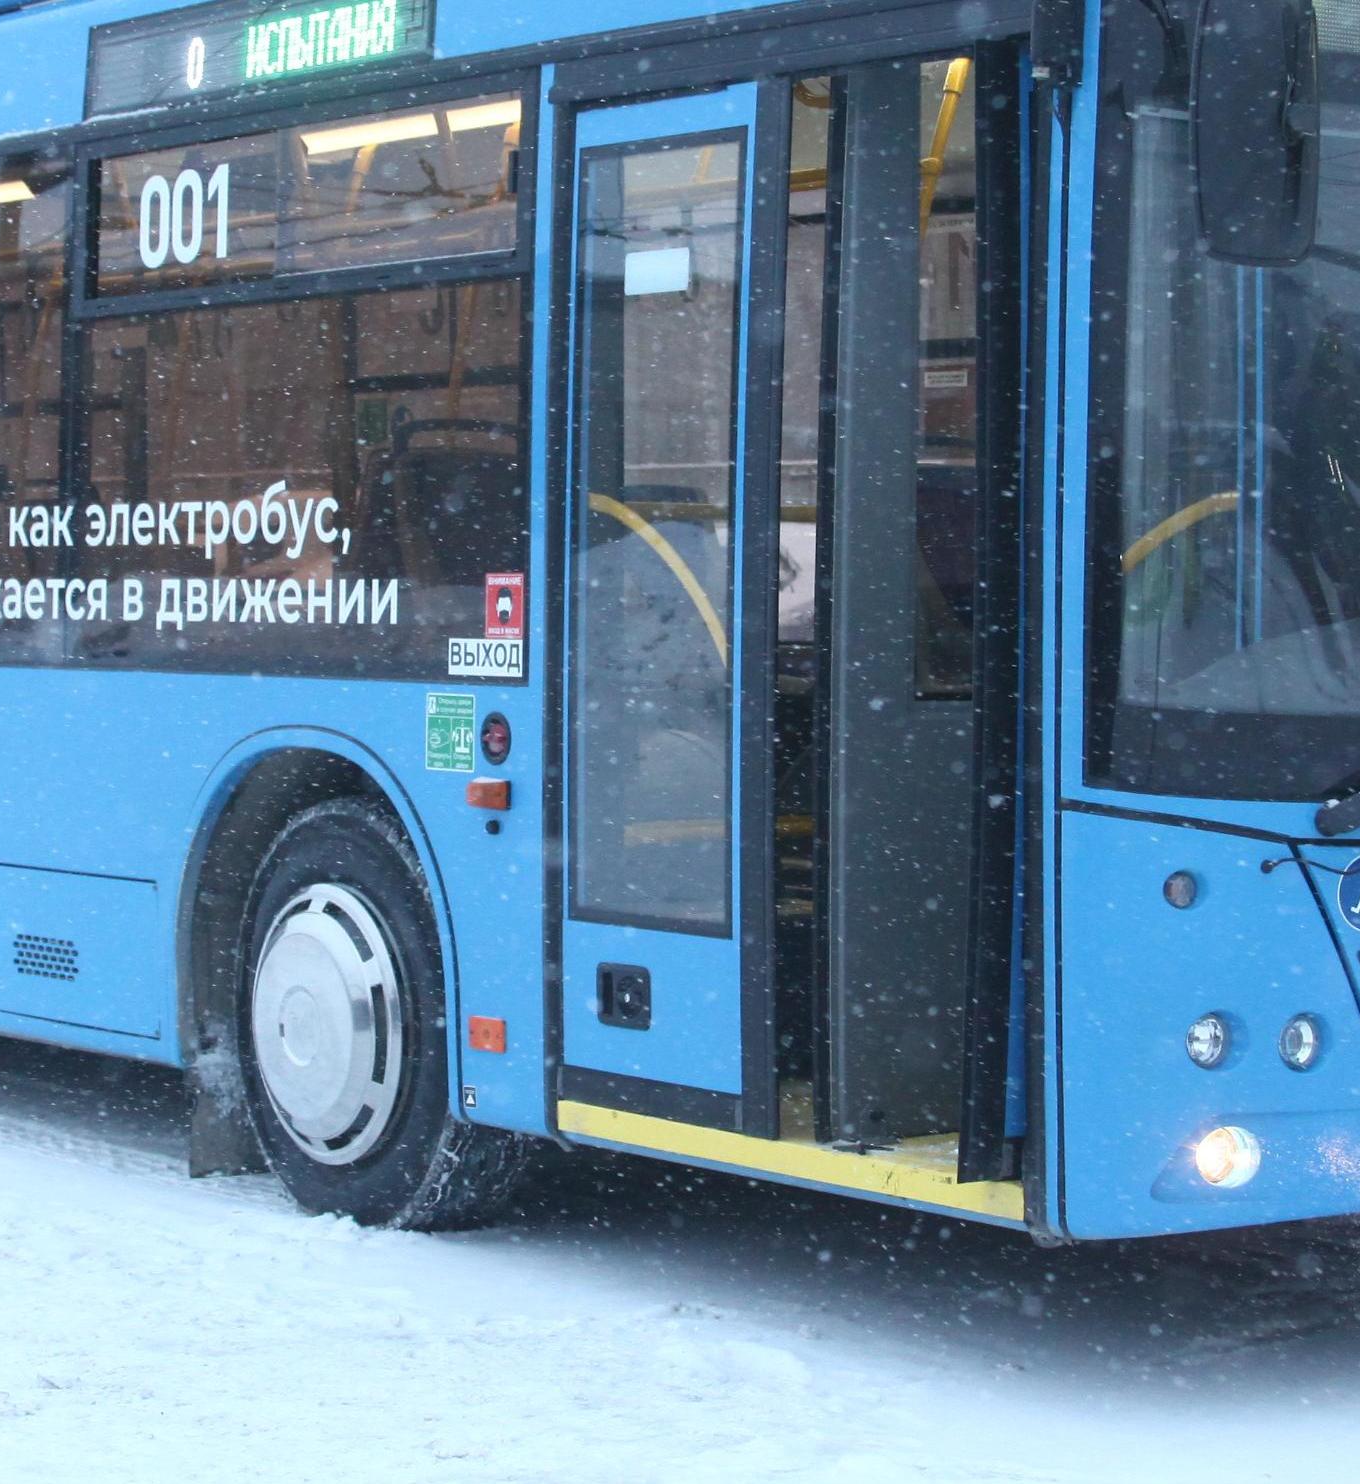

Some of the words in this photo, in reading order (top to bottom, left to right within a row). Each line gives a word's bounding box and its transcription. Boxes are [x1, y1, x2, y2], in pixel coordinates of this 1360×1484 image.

[246, 0, 396, 79] ИСПЫТАНИЯ
[139, 163, 229, 269] 001
[9, 505, 74, 548] как
[85, 480, 351, 559] электробус,
[122, 578, 144, 621] в
[156, 578, 398, 630] движении
[450, 642, 521, 673] ВЫХОД
